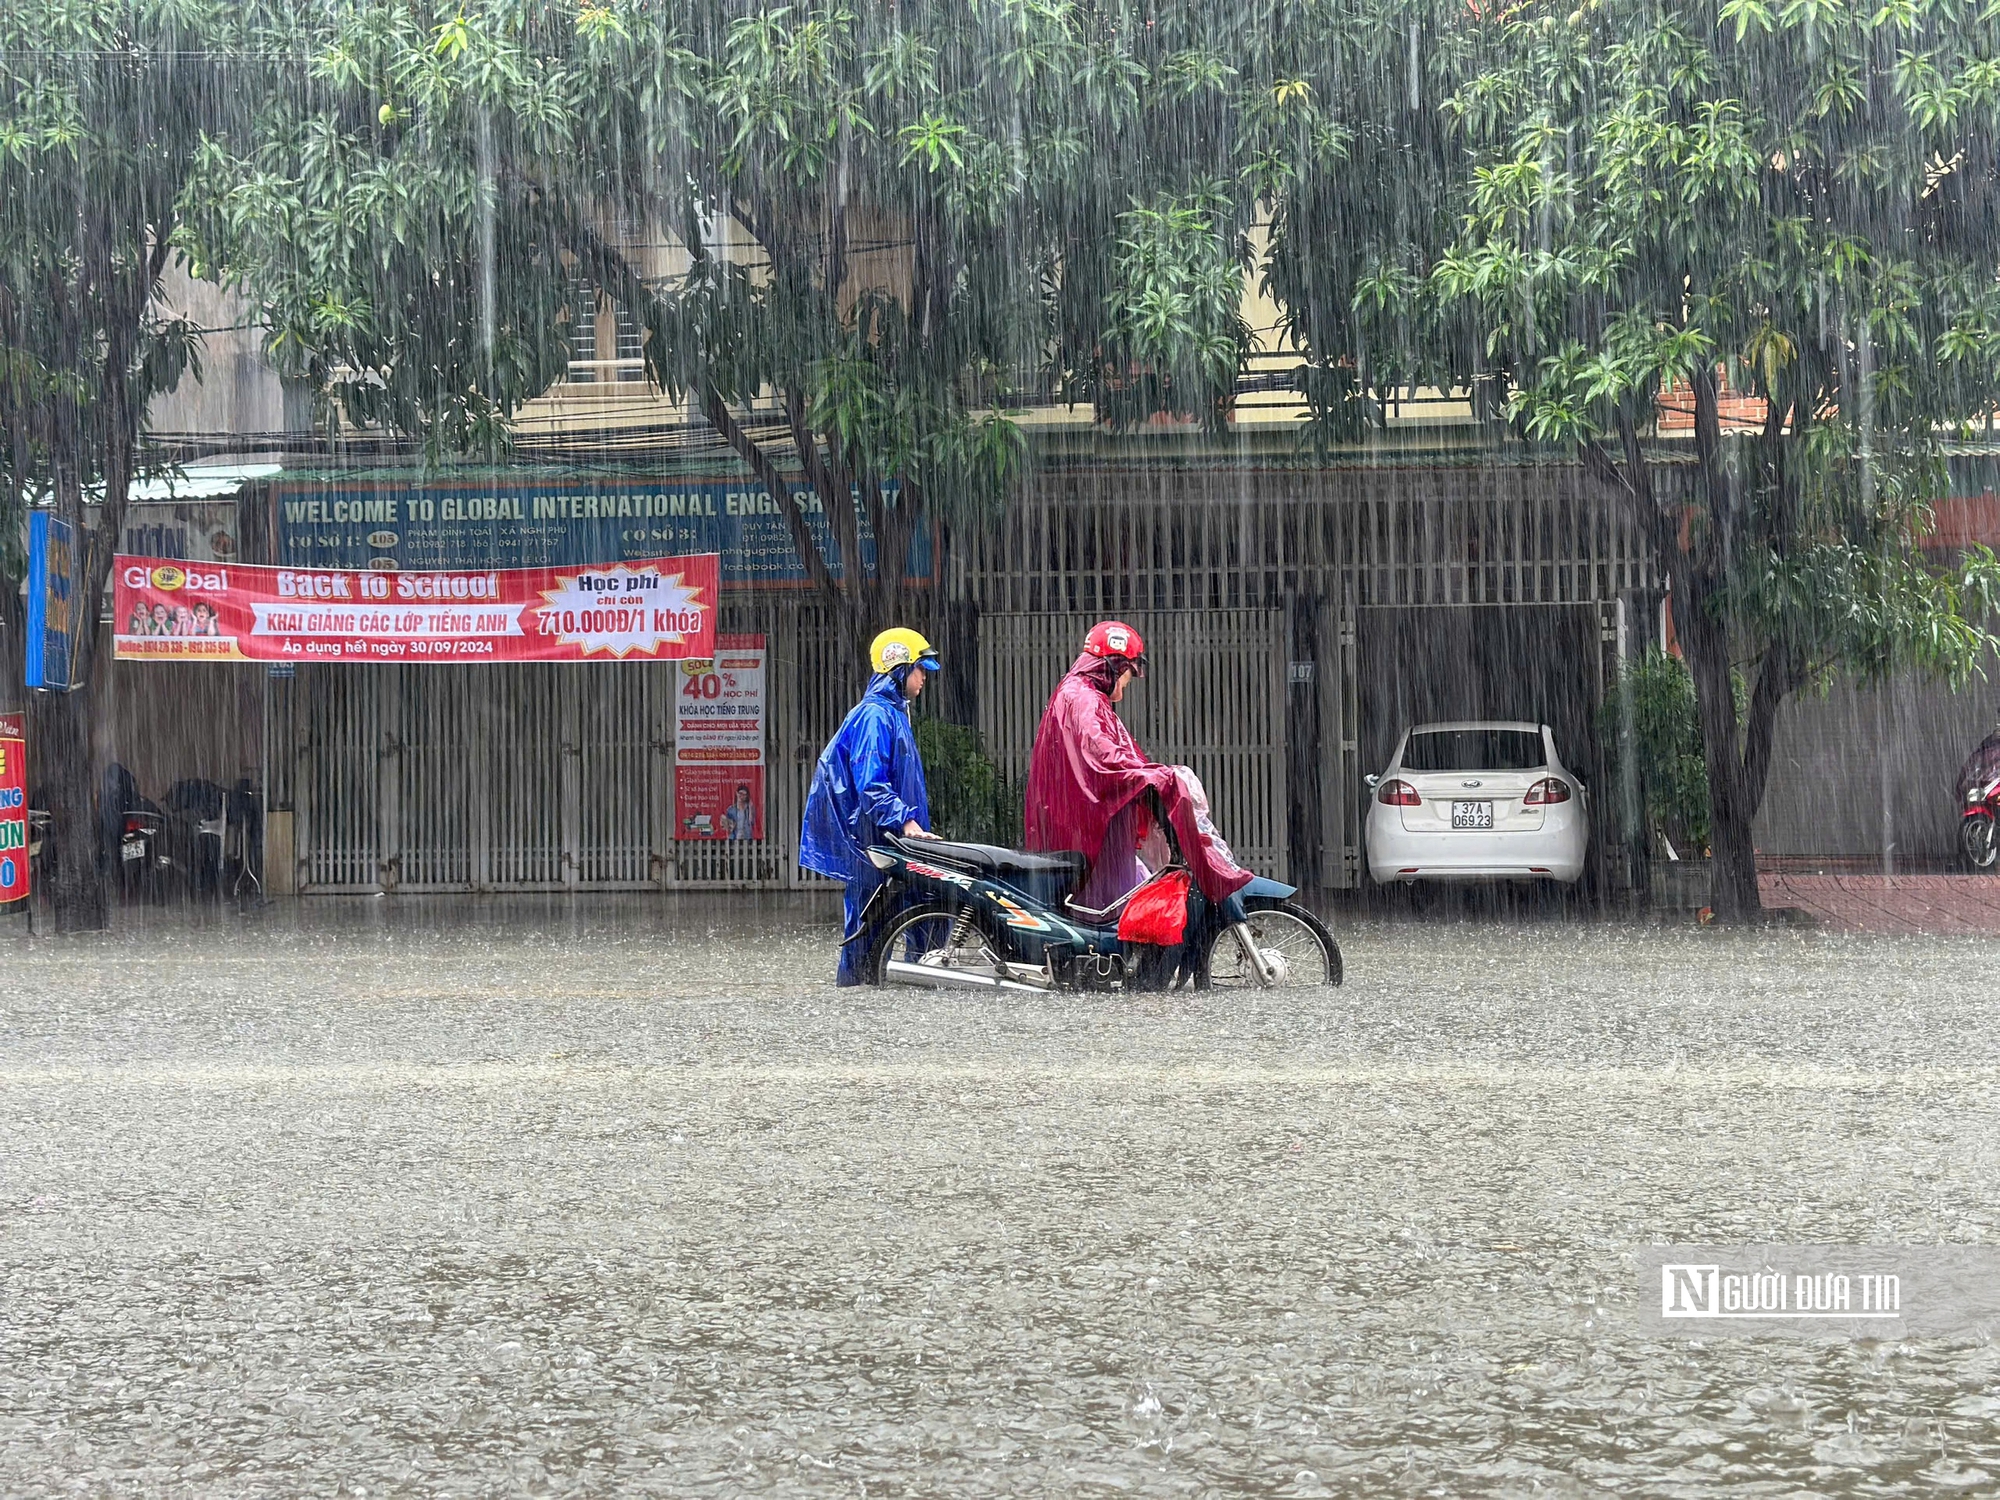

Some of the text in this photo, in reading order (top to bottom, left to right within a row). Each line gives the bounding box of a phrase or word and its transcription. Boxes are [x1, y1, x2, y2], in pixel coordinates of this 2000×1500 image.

[284, 500, 398, 523] WELCOME
[406, 500, 435, 522] TO
[441, 497, 525, 521] GLOBAL
[533, 494, 717, 520] INTERNATIONAL
[371, 534, 395, 544] 105
[277, 571, 500, 600] Back To School
[578, 573, 660, 595] Học phí
[620, 595, 643, 605] còn
[267, 608, 508, 632] KHAI GIẢNG CÁC LỚP TIẾNG ANH
[538, 606, 702, 634] 710.000Đ/1 khóa
[282, 637, 493, 656] Áp dụng hết ngày 30/09/2024
[1292, 664, 1312, 678] 107
[723, 688, 758, 699] HỌC PHÍ
[700, 705, 715, 718] HỌC
[716, 702, 736, 715] TIẾNG
[738, 705, 760, 715] TRUNG
[0, 787, 23, 807] NG
[1462, 803, 1483, 815] 37A
[0, 820, 25, 849] ƠN
